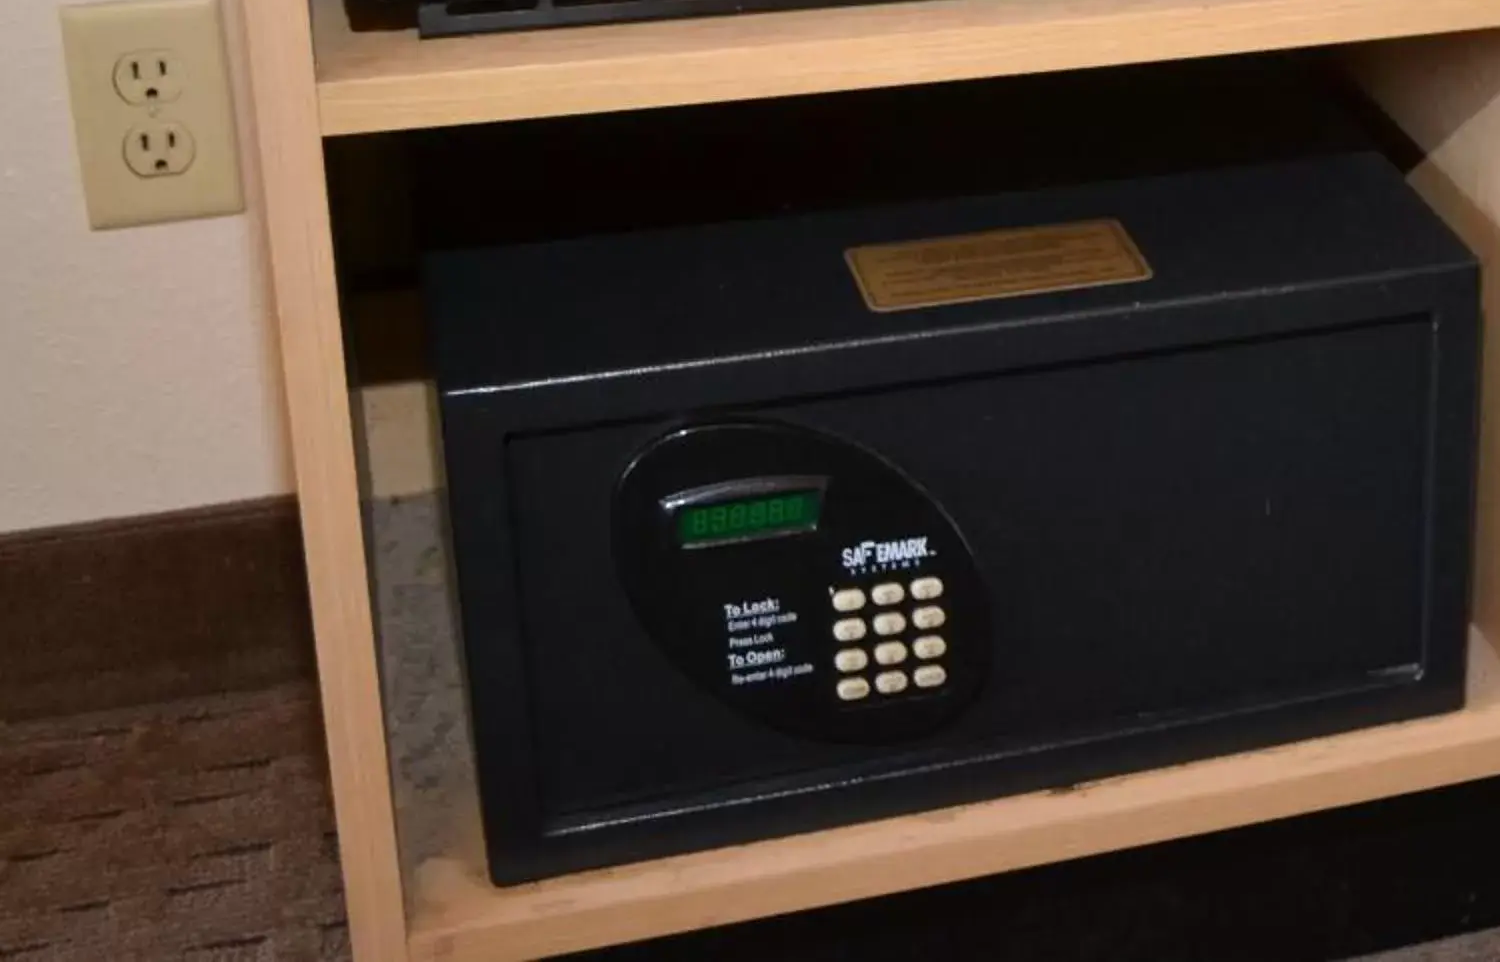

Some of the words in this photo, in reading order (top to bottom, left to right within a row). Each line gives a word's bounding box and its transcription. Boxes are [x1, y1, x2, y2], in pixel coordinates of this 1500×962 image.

[842, 536, 929, 568] SAFEMARK
[723, 603, 741, 620] To
[743, 597, 780, 616] Lock:
[727, 653, 745, 671] To
[746, 648, 785, 666] Open:
